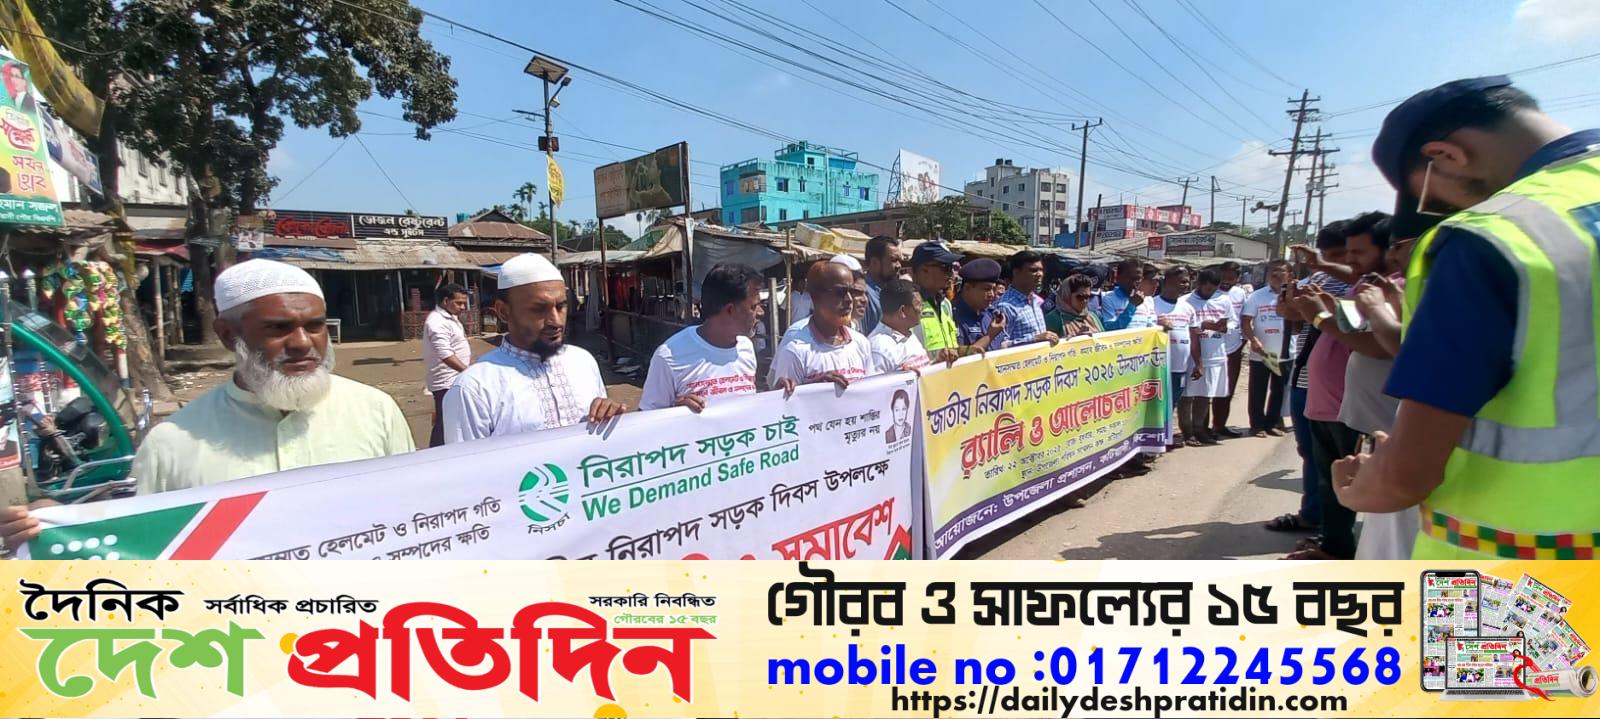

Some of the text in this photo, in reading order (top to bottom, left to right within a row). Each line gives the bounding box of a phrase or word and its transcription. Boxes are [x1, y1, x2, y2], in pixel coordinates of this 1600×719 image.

[975, 383, 1022, 418] নিরাপদ
[1024, 374, 1051, 405] সড়ক
[1084, 363, 1114, 386] ২০২৫
[1029, 414, 1044, 447] ও
[1049, 385, 1131, 438] আলোচনা
[577, 413, 800, 489] নিরাপদ সড়ক চাই
[581, 443, 800, 522] We Demand Safe Road
[608, 459, 891, 560] নিরাপদ সড়ক দিবস উপলক্ষে
[1003, 477, 1054, 508] উপজেলা
[318, 524, 388, 558] হেলমেট
[393, 524, 408, 537] ও
[411, 505, 468, 534] নিরাপদ
[472, 496, 502, 517] গতি
[456, 524, 491, 546] ক্ষতি
[772, 496, 897, 560] সমাবেশ
